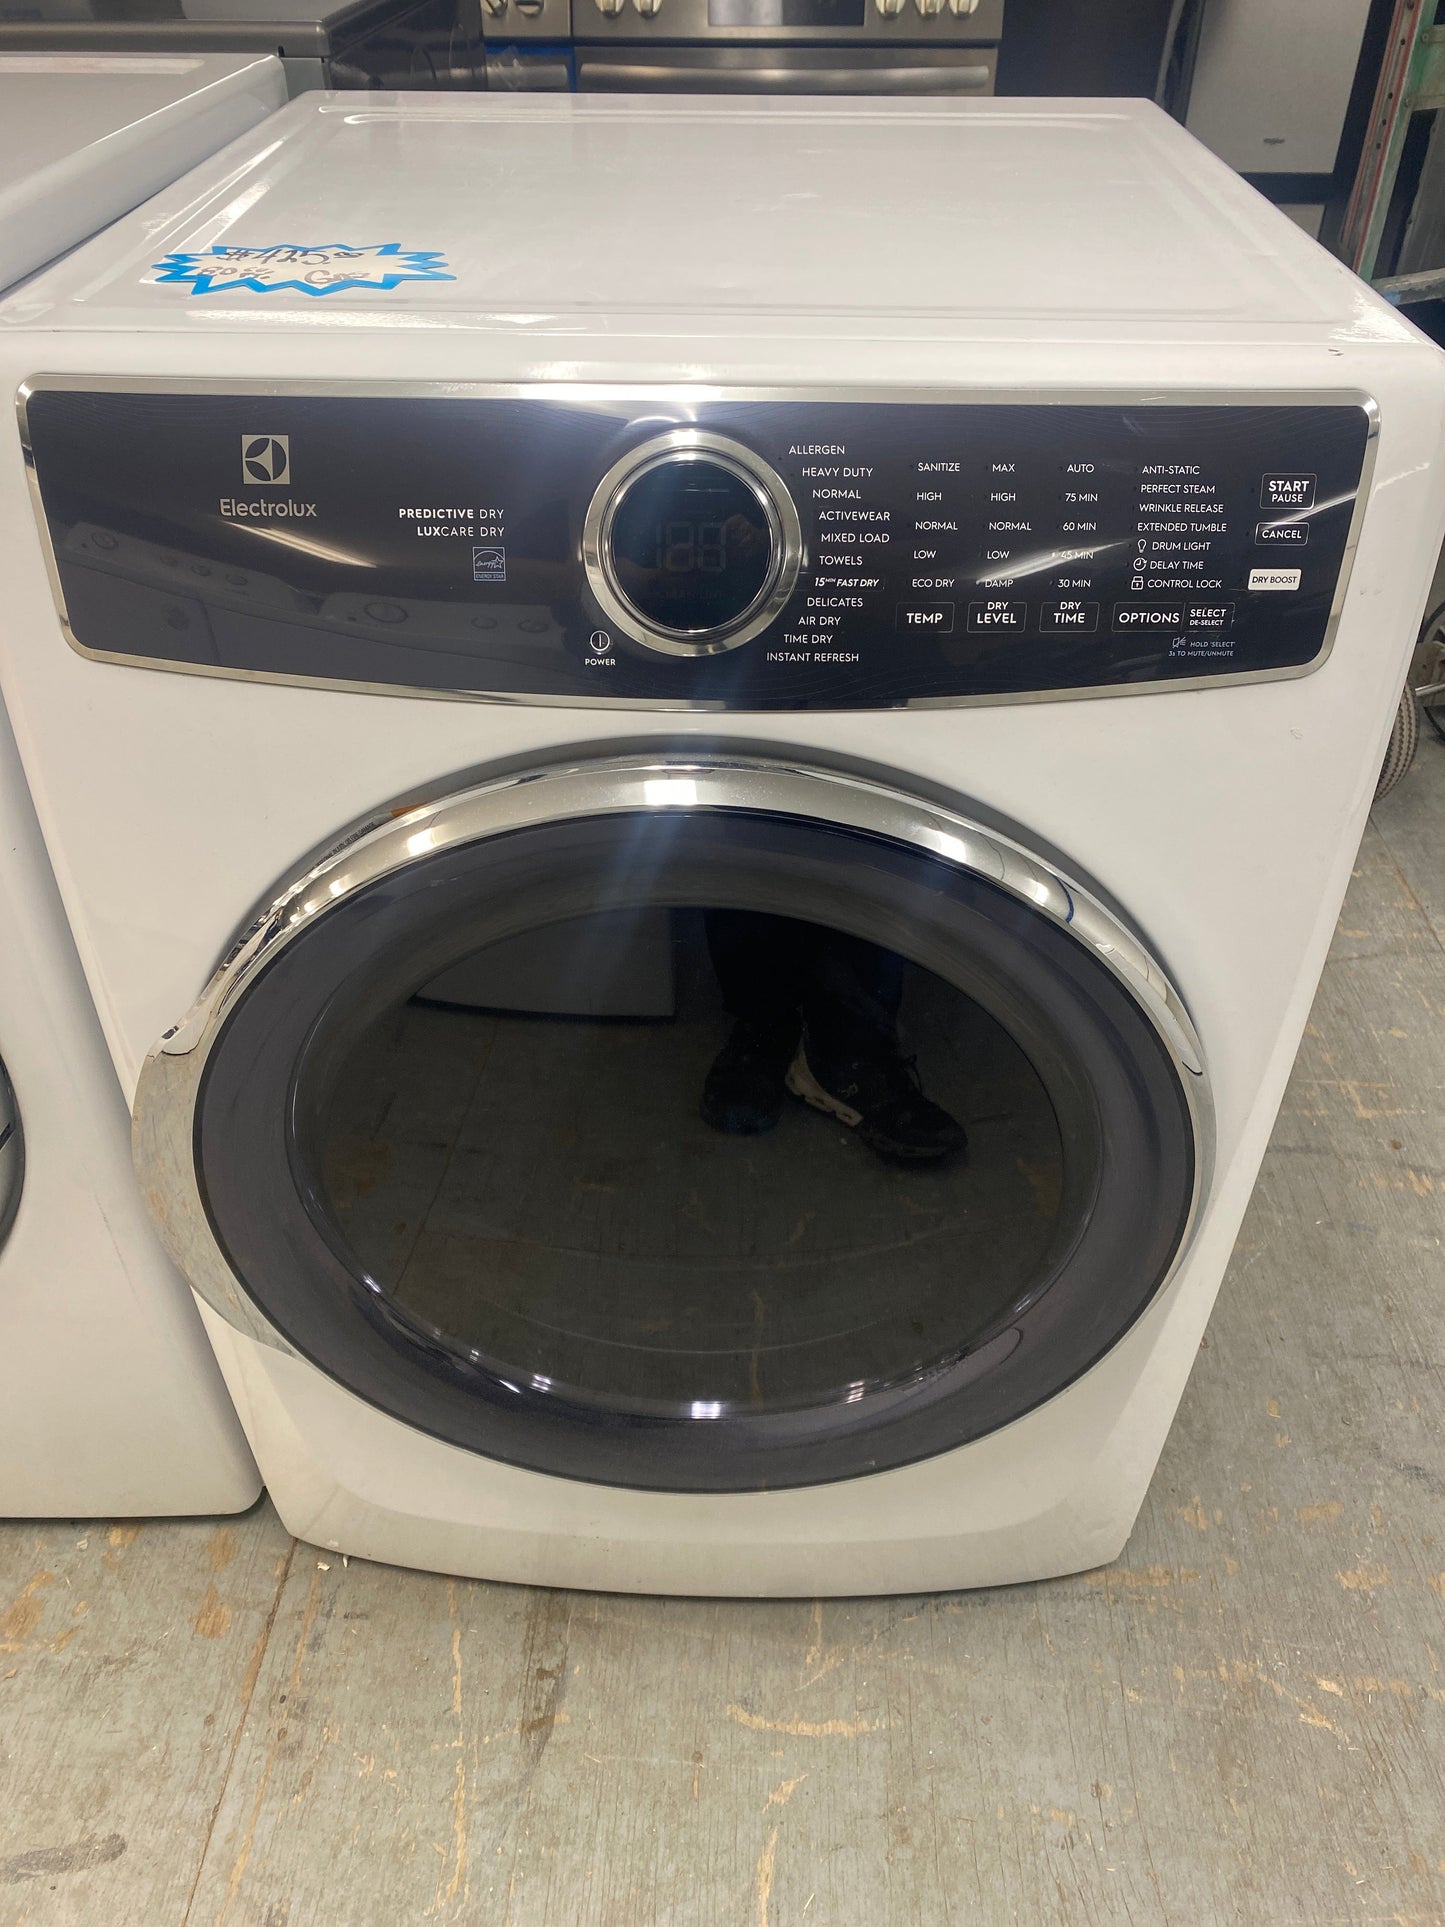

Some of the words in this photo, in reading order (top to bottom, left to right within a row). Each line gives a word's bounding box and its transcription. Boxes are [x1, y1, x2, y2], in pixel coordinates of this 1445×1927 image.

[788, 445, 845, 455] ALLERGEN
[802, 467, 838, 477] HEAVY
[843, 468, 873, 477] DUTY
[917, 462, 961, 472] SANITIZE
[992, 463, 1016, 473] MAX
[1066, 463, 1095, 473] AUTO
[1141, 465, 1201, 475] ANTI-STATIC
[1140, 484, 1181, 494] PERFECT
[1183, 484, 1216, 494] STEAM
[1268, 480, 1310, 492] START
[812, 489, 861, 499] NORMAL
[916, 491, 942, 501] HIGH
[990, 492, 1016, 501] HIGH
[1065, 493, 1077, 502] 75
[1078, 493, 1098, 502] MIN
[1271, 493, 1304, 503] PAUSE
[219, 499, 318, 517] Electrolux
[1139, 503, 1182, 513] WRINKLE
[1184, 504, 1224, 513] RELEASE
[399, 508, 474, 519] PREDICTIVE
[479, 508, 504, 519] DRY
[818, 511, 890, 521] ACTIVEWEAR
[915, 521, 958, 531] NORMAL
[988, 521, 1032, 531] NORMAL
[1062, 522, 1075, 531] 60
[1077, 522, 1097, 531] MIN
[1137, 523, 1188, 532] EXTENDED
[1189, 523, 1227, 532] TUMBLE
[417, 526, 474, 537] LUXCARE
[480, 526, 505, 537] DRY
[1261, 529, 1302, 539] CANCEL
[821, 533, 856, 543] MIXED
[859, 533, 890, 543] LOAD
[1152, 541, 1181, 551] DRUM
[1184, 541, 1211, 551] LIGHT
[913, 550, 937, 559] LOW
[986, 550, 1010, 559] LOW
[1061, 551, 1073, 560] 45
[1074, 551, 1094, 560] MIN
[819, 555, 863, 565] TOWELS
[1150, 560, 1180, 570] DELAY
[1181, 560, 1204, 570] TIME
[836, 578, 859, 587] FAST
[859, 578, 880, 587] DRY
[912, 578, 933, 588] ECO
[935, 578, 955, 588] DRY
[985, 579, 1014, 588] DAMP
[1057, 579, 1070, 588] 30
[1072, 579, 1091, 588] MIN
[1147, 579, 1194, 589] CONTROL
[1196, 579, 1222, 589] LOCK
[1252, 575, 1268, 584] DRY
[1269, 575, 1298, 584] BOOST
[807, 597, 863, 607] DELICATES
[987, 602, 1009, 610] DRY
[1059, 602, 1081, 610] DRY
[1189, 608, 1227, 617] SELECT
[798, 616, 817, 626] AIR
[819, 616, 841, 626] DRY
[906, 613, 943, 624] TEMP
[976, 613, 1017, 624] LEVEL
[1053, 613, 1085, 624] TIME
[1118, 612, 1180, 624] OPTIONS
[784, 634, 808, 644] TIME
[811, 634, 833, 644] DRY
[584, 658, 616, 666] POWER
[766, 652, 811, 662] INSTANT
[814, 652, 859, 663] REFRESH
